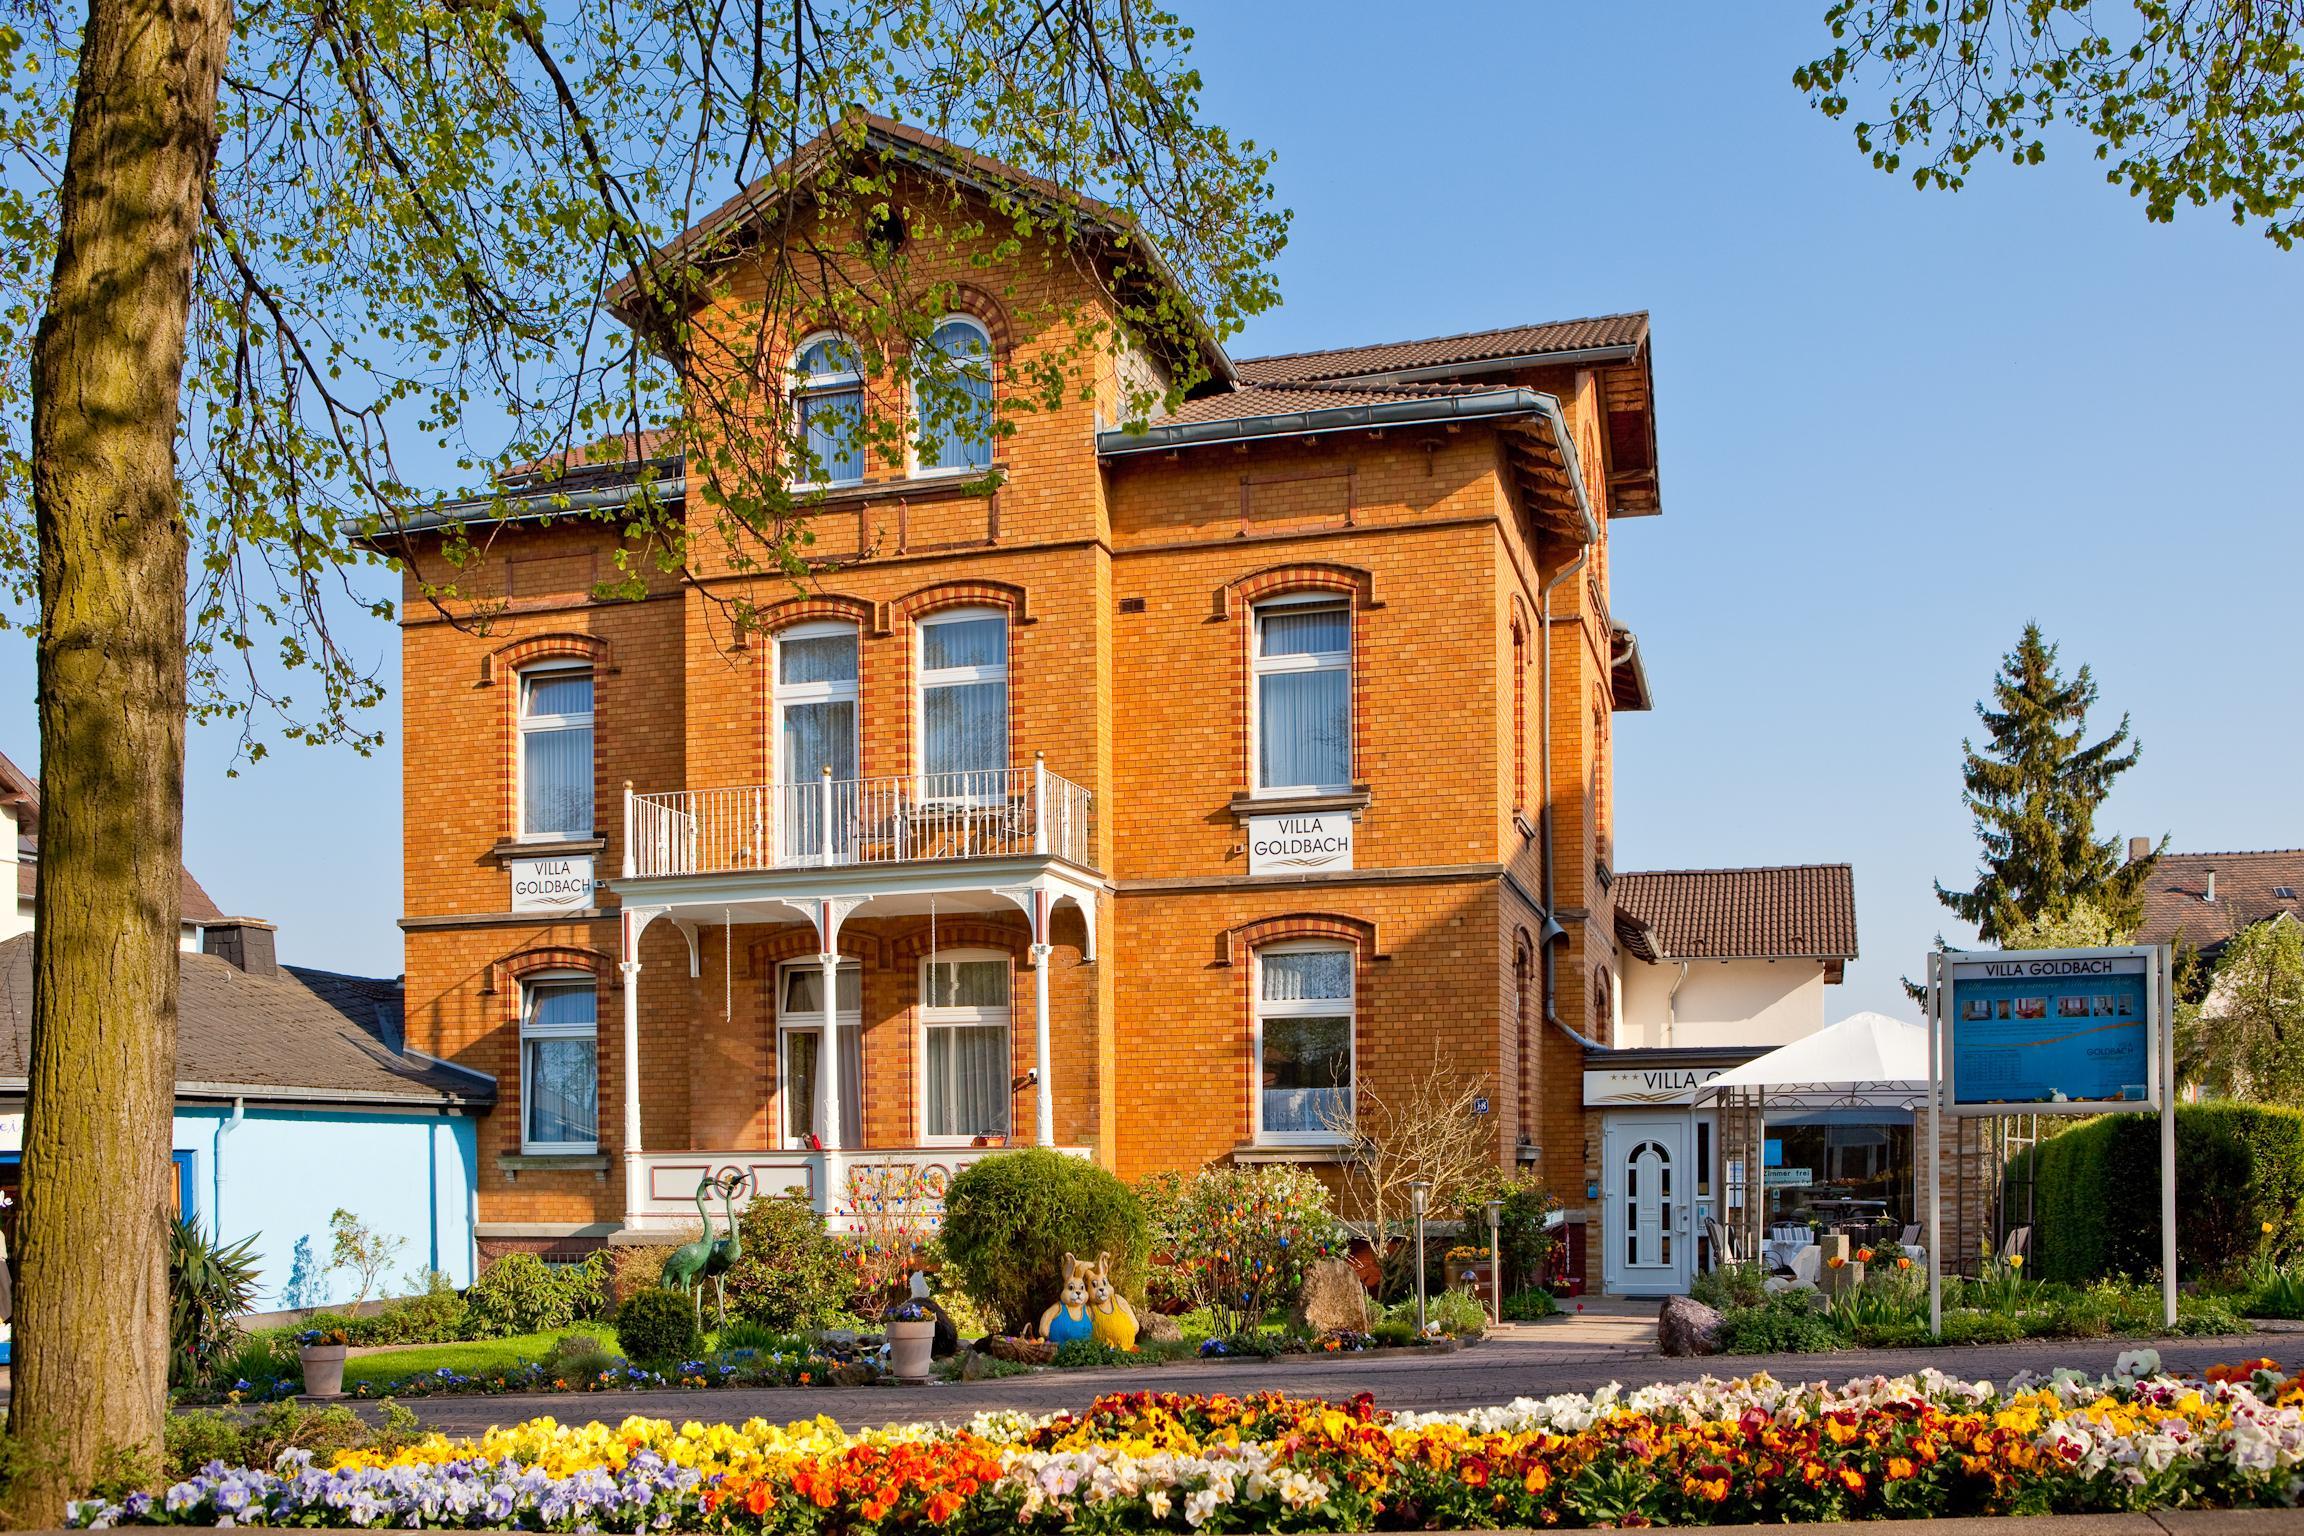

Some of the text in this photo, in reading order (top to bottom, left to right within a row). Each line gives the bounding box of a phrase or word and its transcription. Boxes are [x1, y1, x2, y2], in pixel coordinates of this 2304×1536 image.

[1278, 818, 1323, 834] VILLA
[1254, 837, 1348, 855] GOLDBACH
[535, 861, 571, 875] VILLA
[516, 879, 590, 894] GOLDBACH
[1985, 960, 2112, 976] VILLA GOLDBACH
[1643, 1071, 1698, 1089] VILLA
[1796, 1169, 1810, 1177] frei
